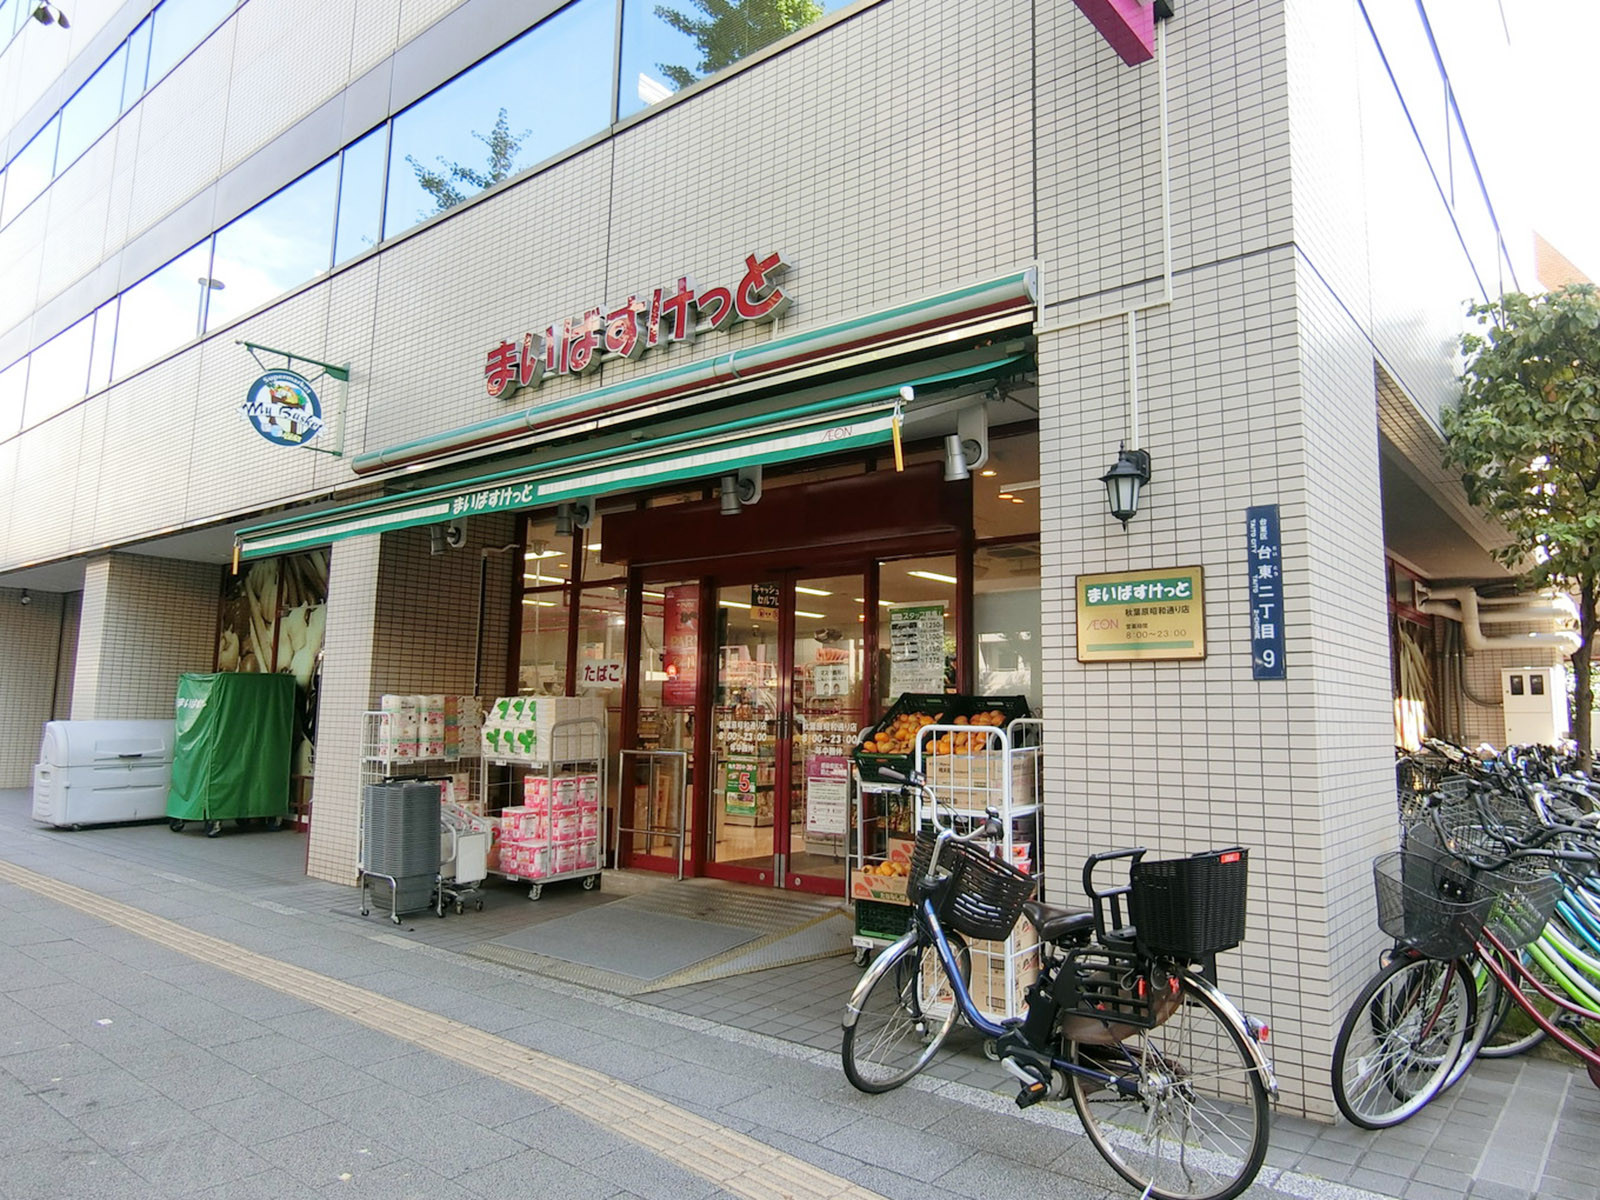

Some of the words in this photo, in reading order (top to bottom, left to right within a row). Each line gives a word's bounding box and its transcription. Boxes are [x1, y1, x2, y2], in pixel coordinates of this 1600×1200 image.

[484, 252, 788, 399] まいばすけっと
[242, 402, 272, 418] My
[453, 484, 534, 515] まいばすけっと
[1250, 538, 1258, 554] CITY
[1087, 581, 1191, 603] まいばすけっと
[1262, 649, 1276, 669] 9
[584, 664, 620, 682] たばこ
